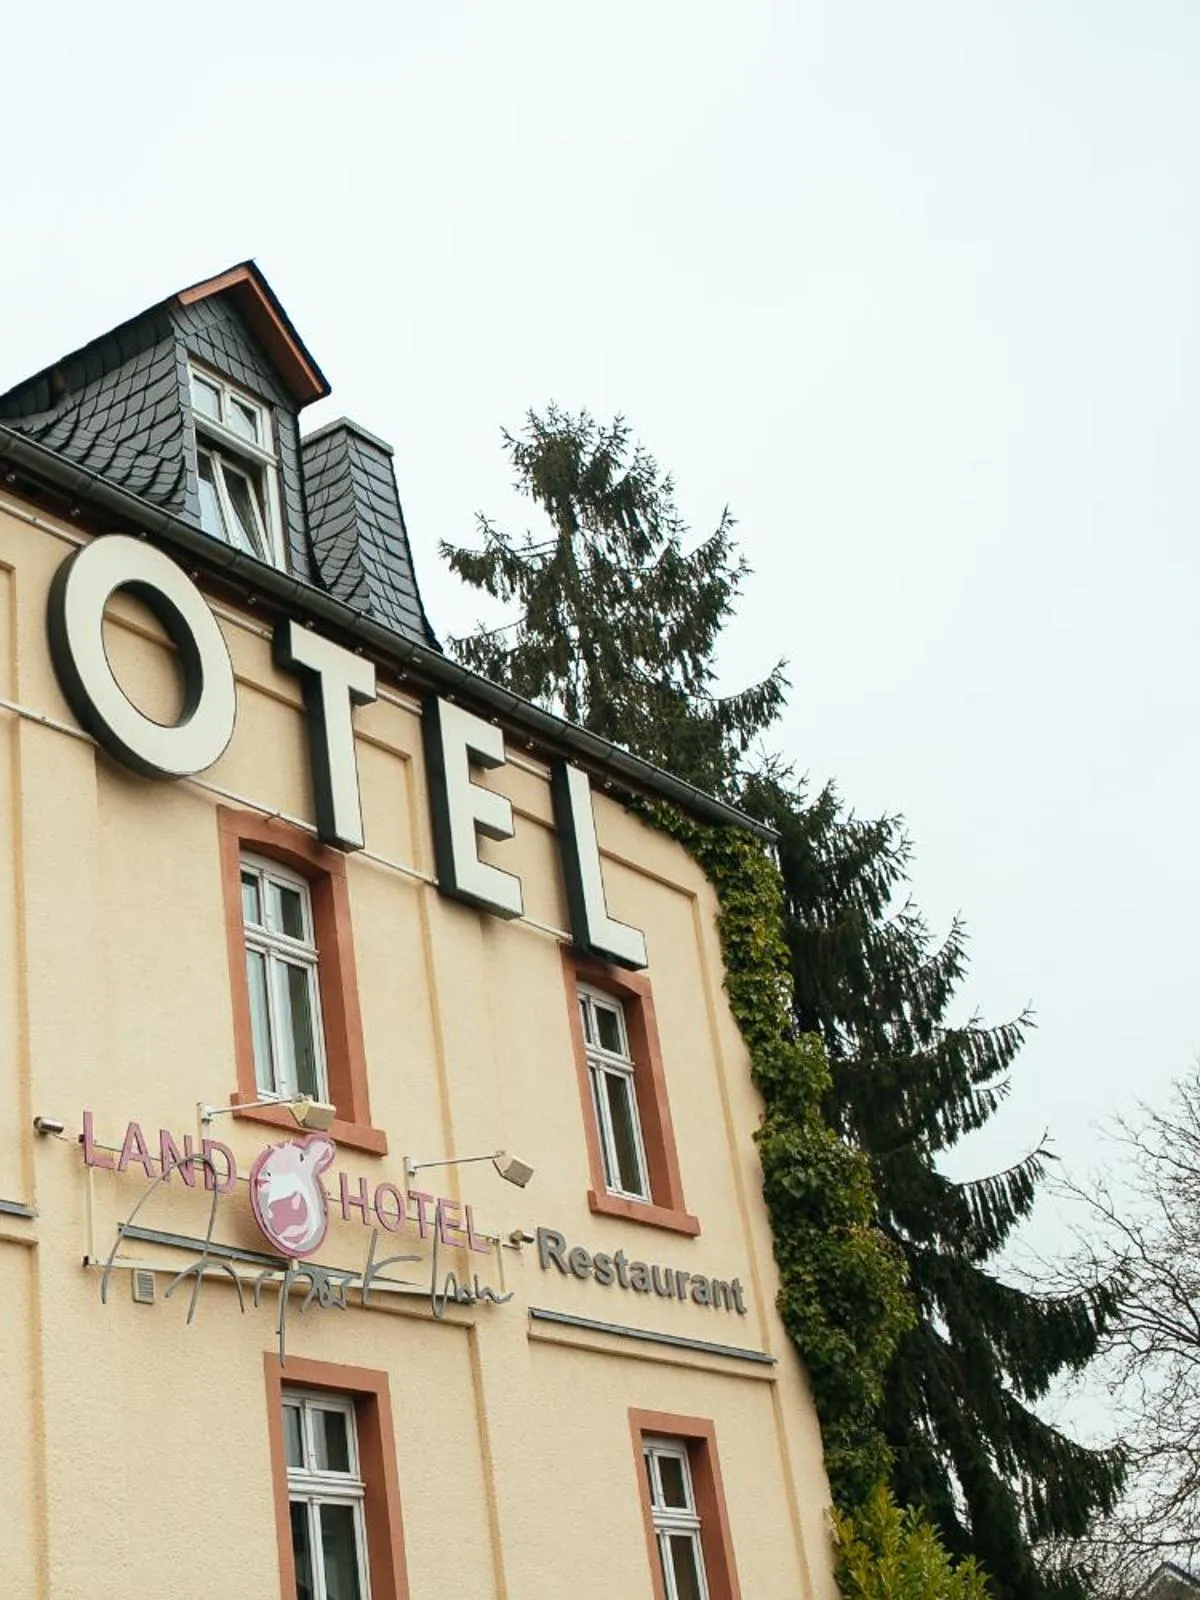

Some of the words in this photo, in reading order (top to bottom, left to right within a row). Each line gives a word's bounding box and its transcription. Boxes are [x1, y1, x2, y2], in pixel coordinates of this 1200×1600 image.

[82, 1108, 237, 1194] LAND
[338, 1172, 491, 1255] HOTEL
[537, 1226, 748, 1316] Restaurant
